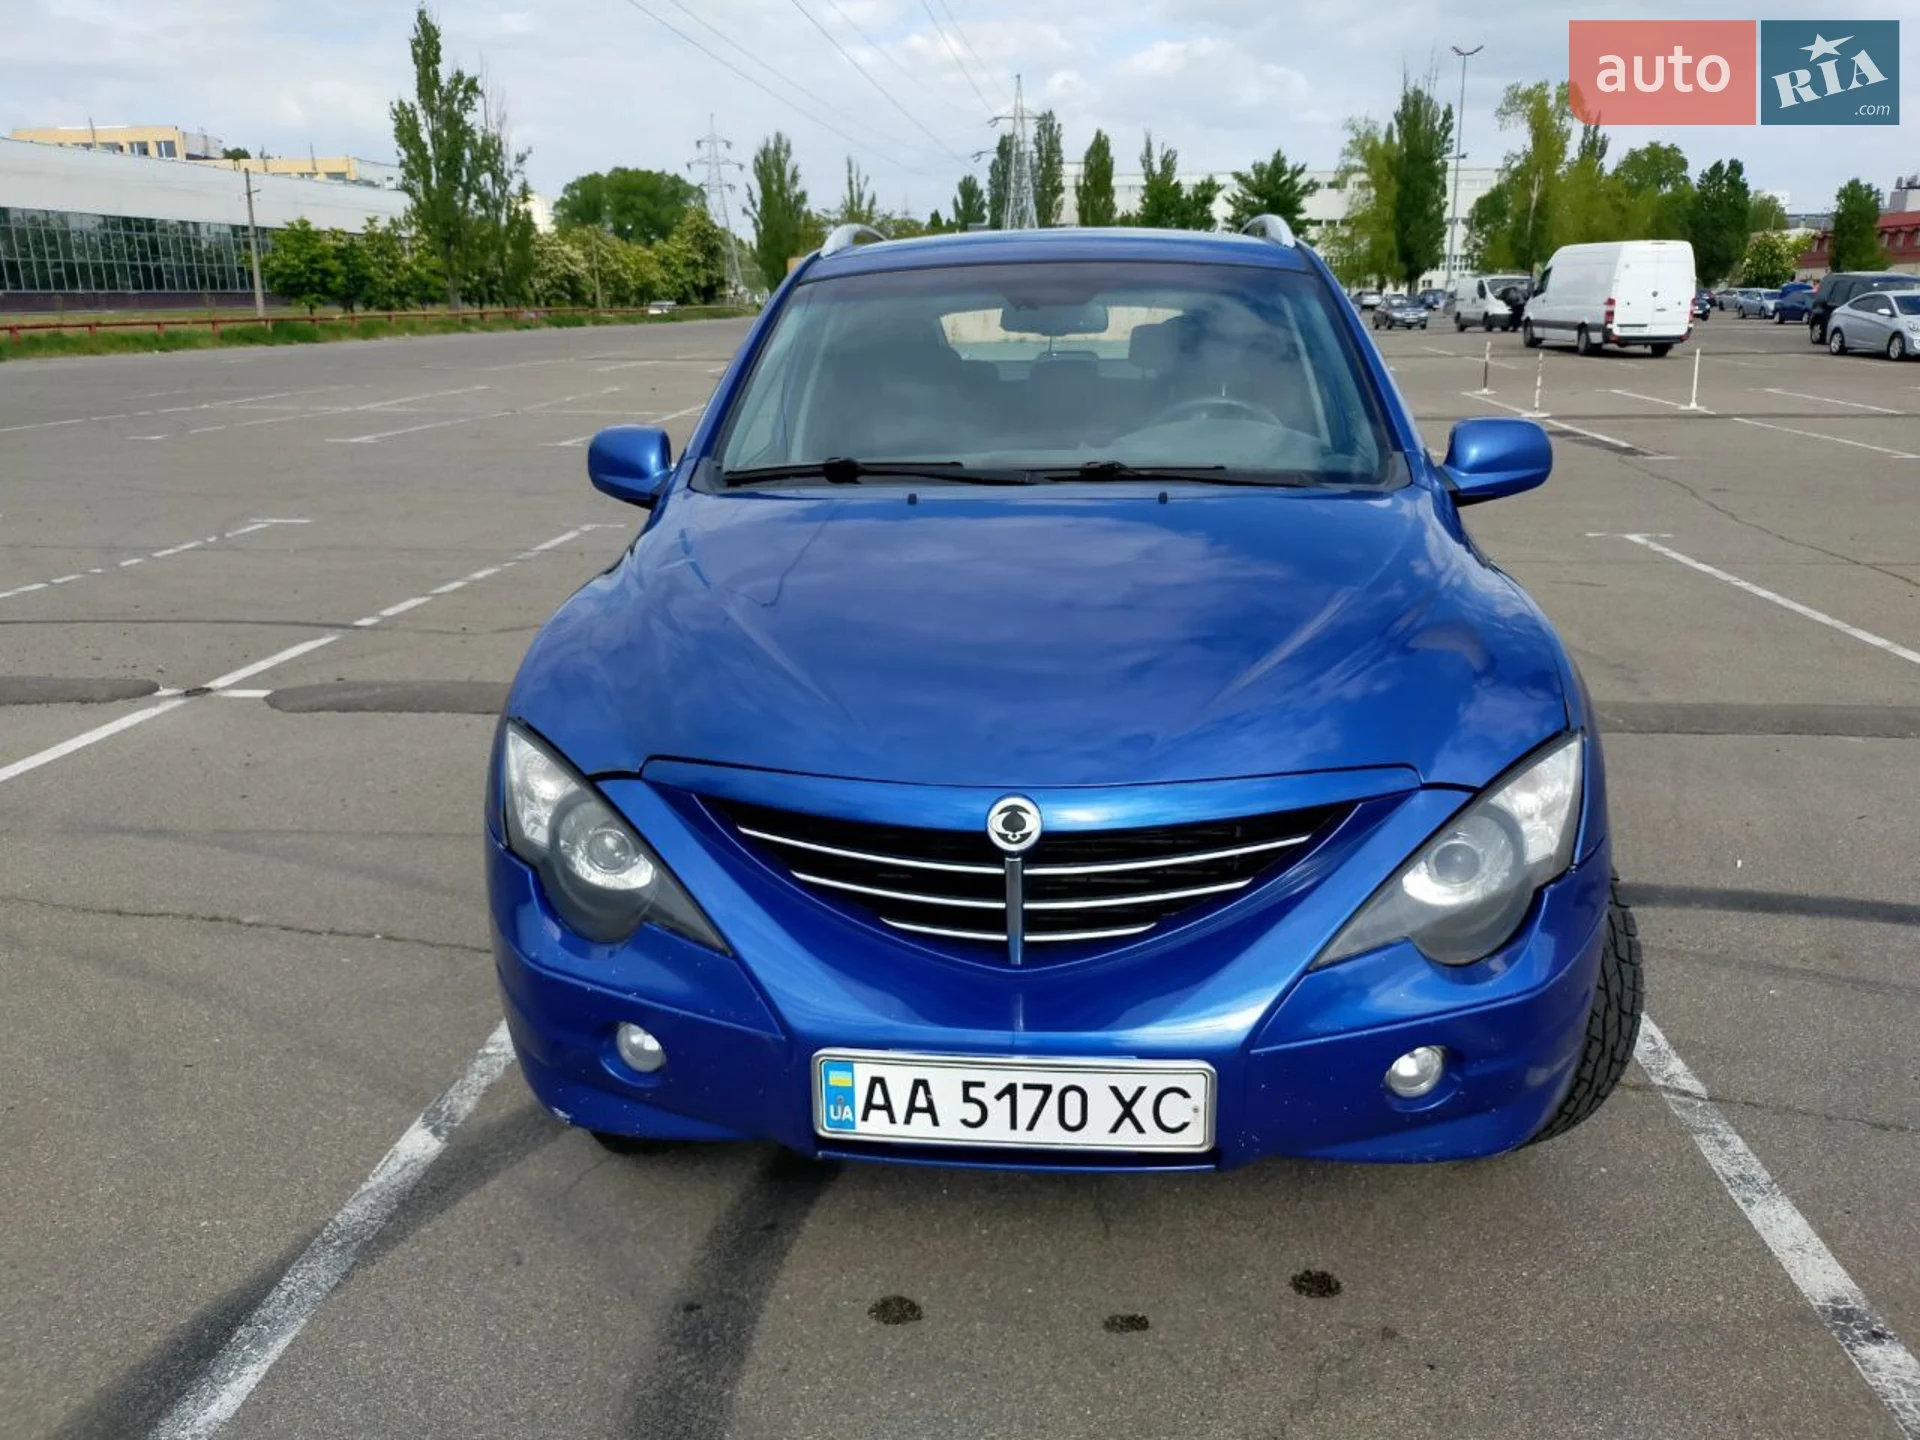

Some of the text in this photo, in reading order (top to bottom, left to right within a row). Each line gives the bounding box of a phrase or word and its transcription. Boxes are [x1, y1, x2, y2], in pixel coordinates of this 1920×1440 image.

[829, 1105, 854, 1123] UA
[861, 1075, 1192, 1134] AA 5170 XC
